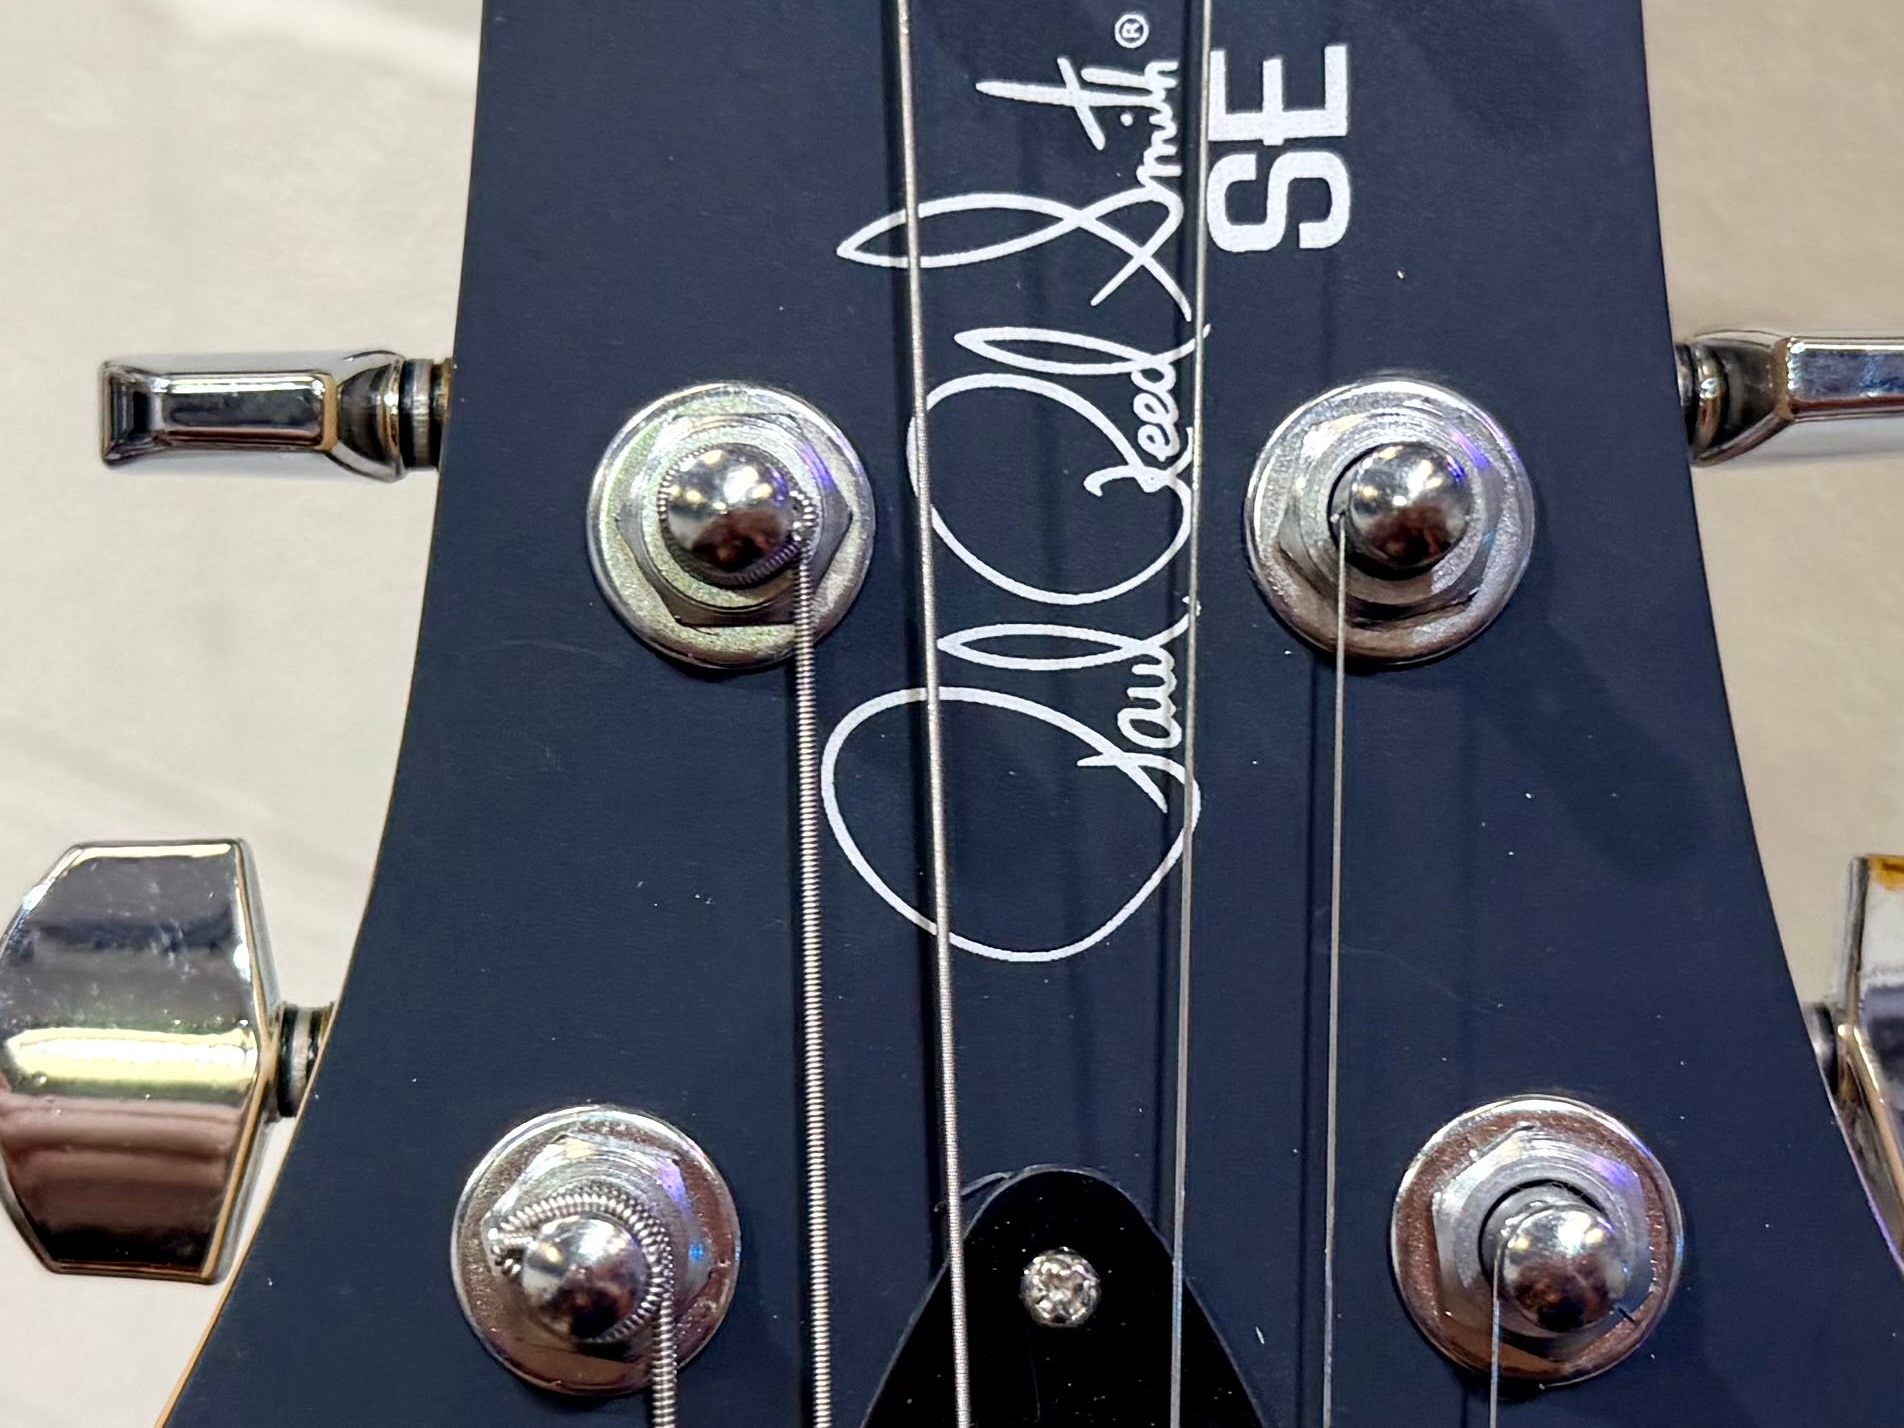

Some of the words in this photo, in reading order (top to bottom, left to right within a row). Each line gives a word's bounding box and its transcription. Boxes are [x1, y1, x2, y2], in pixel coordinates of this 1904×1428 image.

[1205, 43, 1352, 253] SE
[905, 323, 1211, 606] Reed
[821, 598, 1202, 962] Paul
